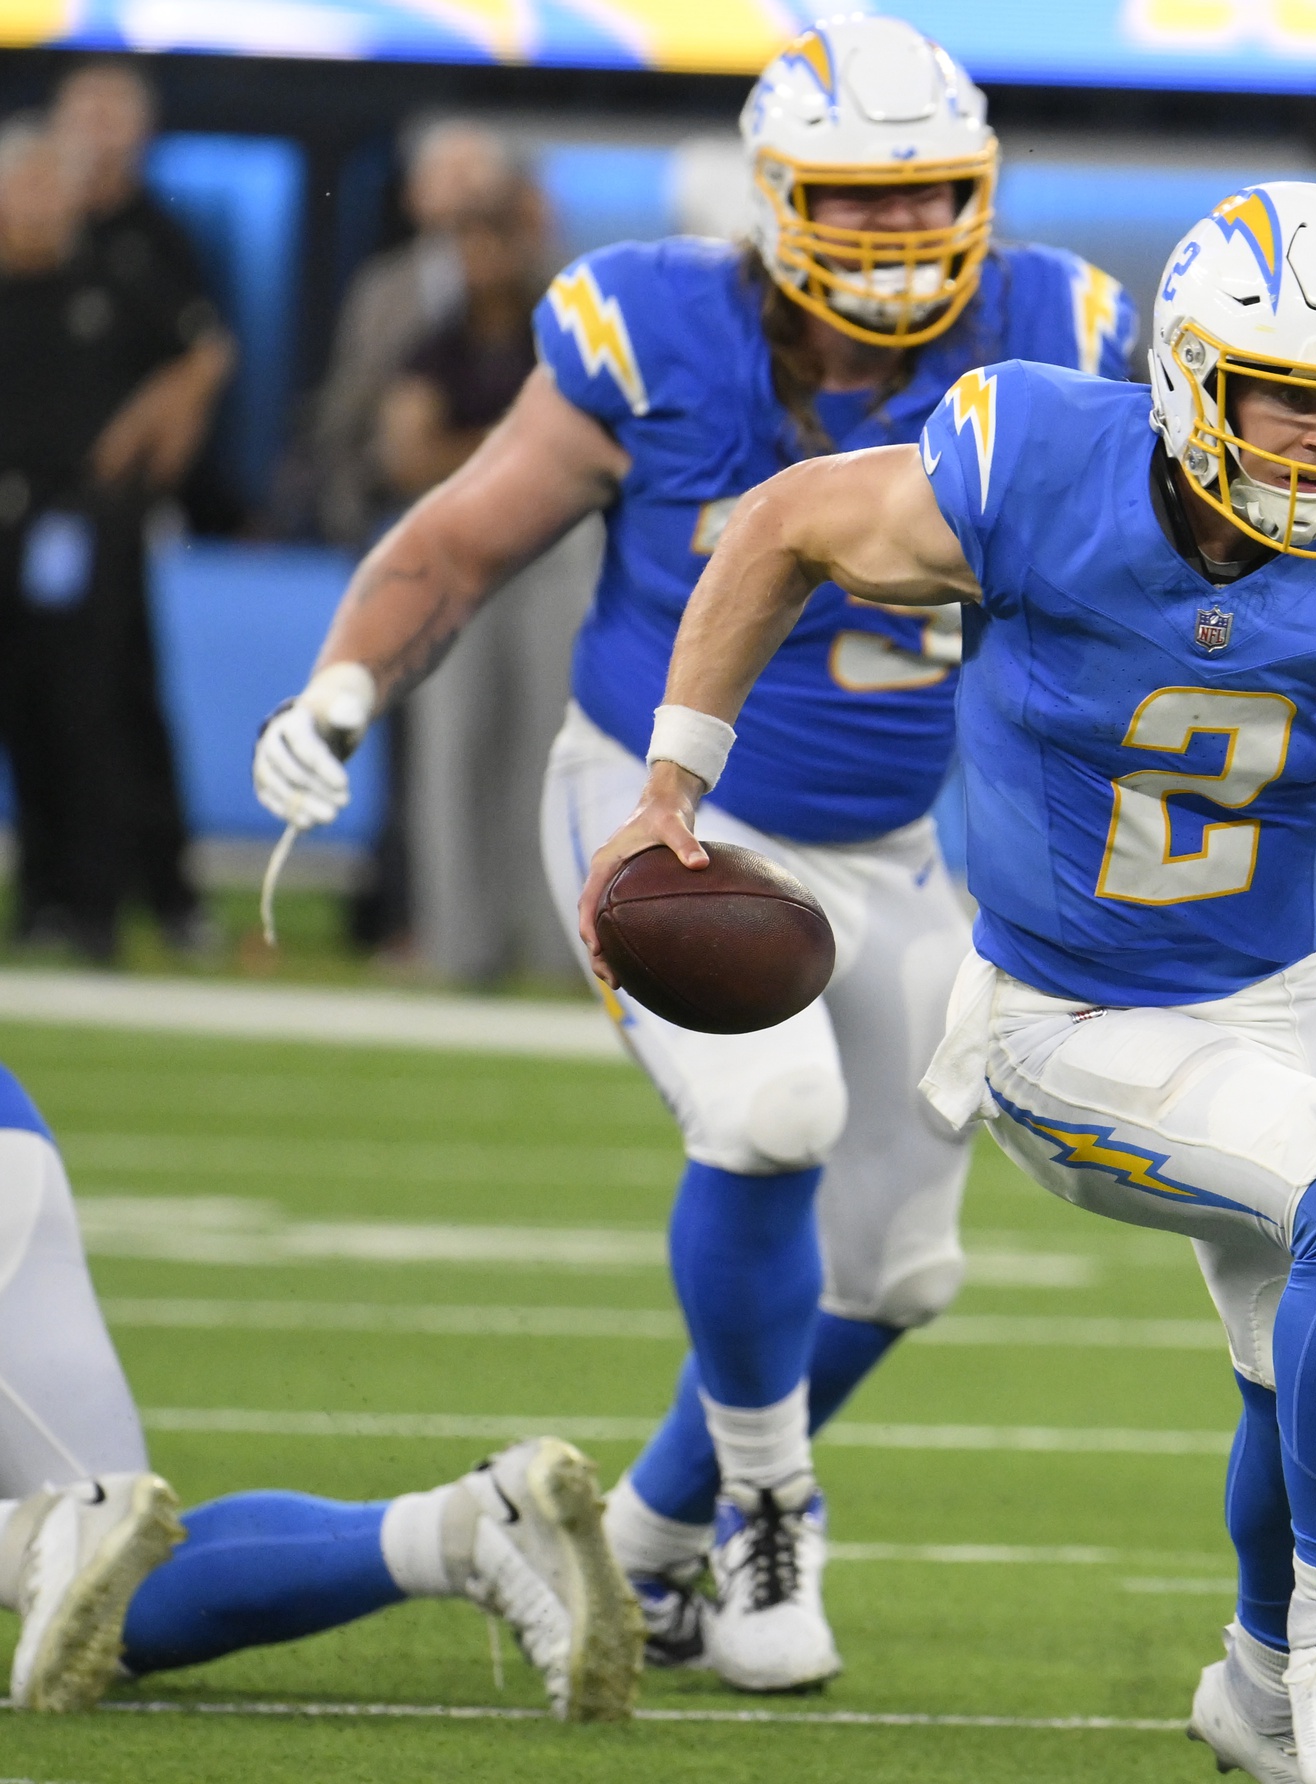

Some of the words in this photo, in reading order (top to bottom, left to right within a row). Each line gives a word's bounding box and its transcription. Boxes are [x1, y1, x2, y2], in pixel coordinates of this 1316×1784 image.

[1161, 240, 1202, 302] 2
[1200, 626, 1224, 645] NFL
[1094, 685, 1298, 907] 2
